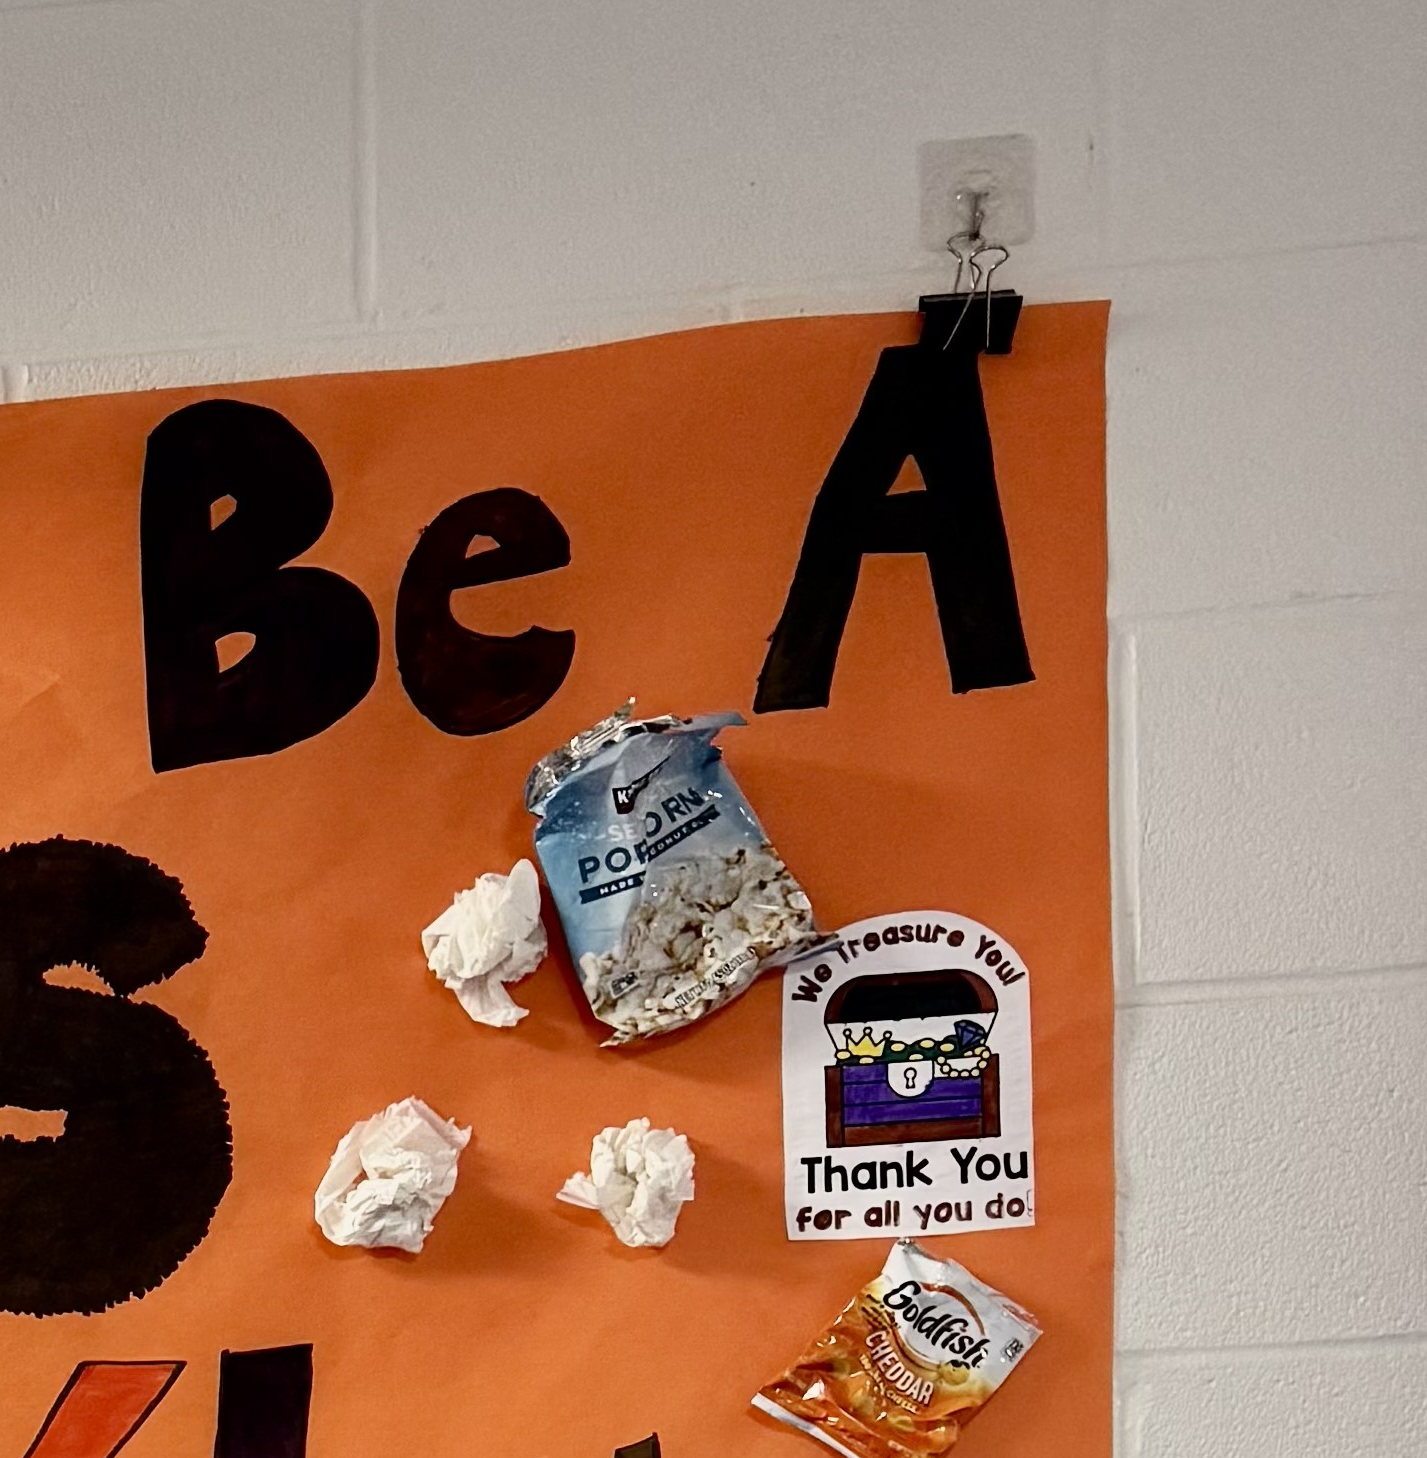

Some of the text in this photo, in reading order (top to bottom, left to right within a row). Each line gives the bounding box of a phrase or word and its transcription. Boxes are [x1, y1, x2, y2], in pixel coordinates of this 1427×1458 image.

[139, 398, 576, 773] Be
[753, 344, 1036, 713] A
[791, 963, 833, 1003] We
[836, 923, 965, 964] Treasure
[975, 934, 1026, 987] You!
[800, 1146, 1030, 1194] Thank You
[796, 1206, 852, 1232] for
[863, 1199, 901, 1228] all
[913, 1200, 973, 1231] you
[883, 1279, 990, 1370] Goldfish
[865, 1331, 934, 1406] CHEDDAR
